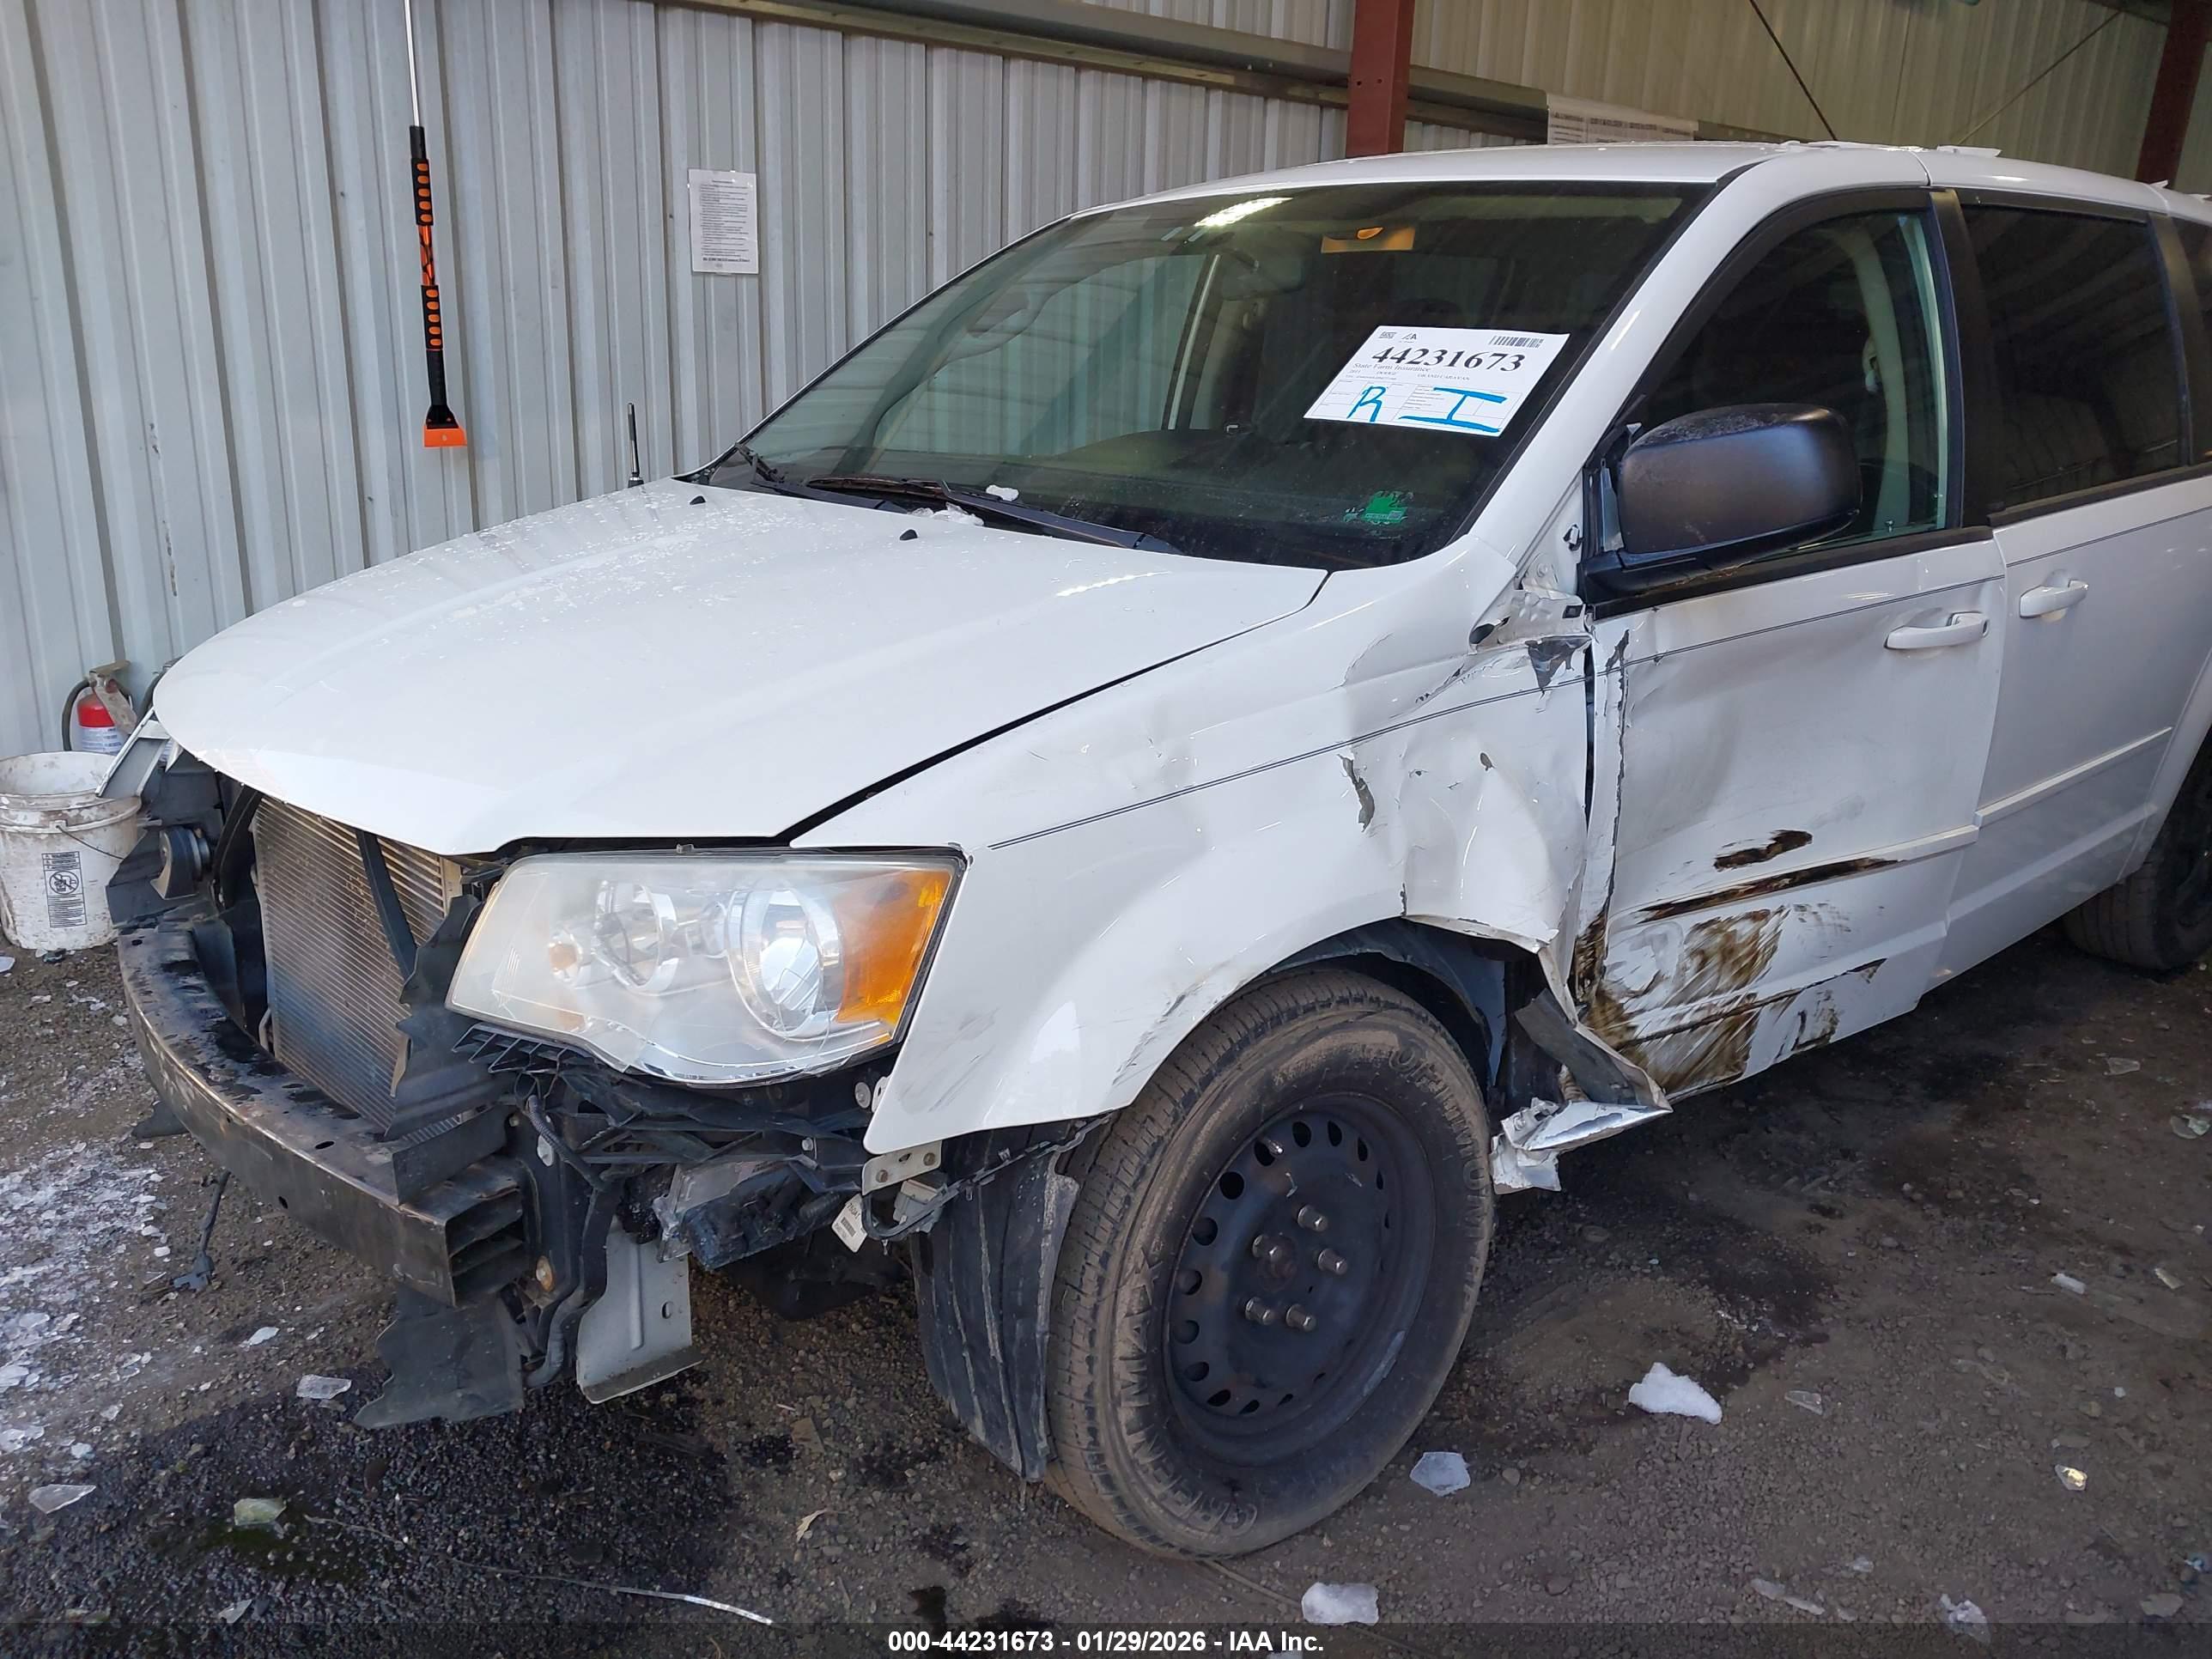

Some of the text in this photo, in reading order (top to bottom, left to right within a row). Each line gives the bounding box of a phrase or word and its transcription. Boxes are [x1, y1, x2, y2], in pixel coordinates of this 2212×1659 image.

[1371, 346, 1526, 372] 44231673
[1346, 386, 1387, 422] R
[1118, 1245, 1258, 1534] GREEN MAX
